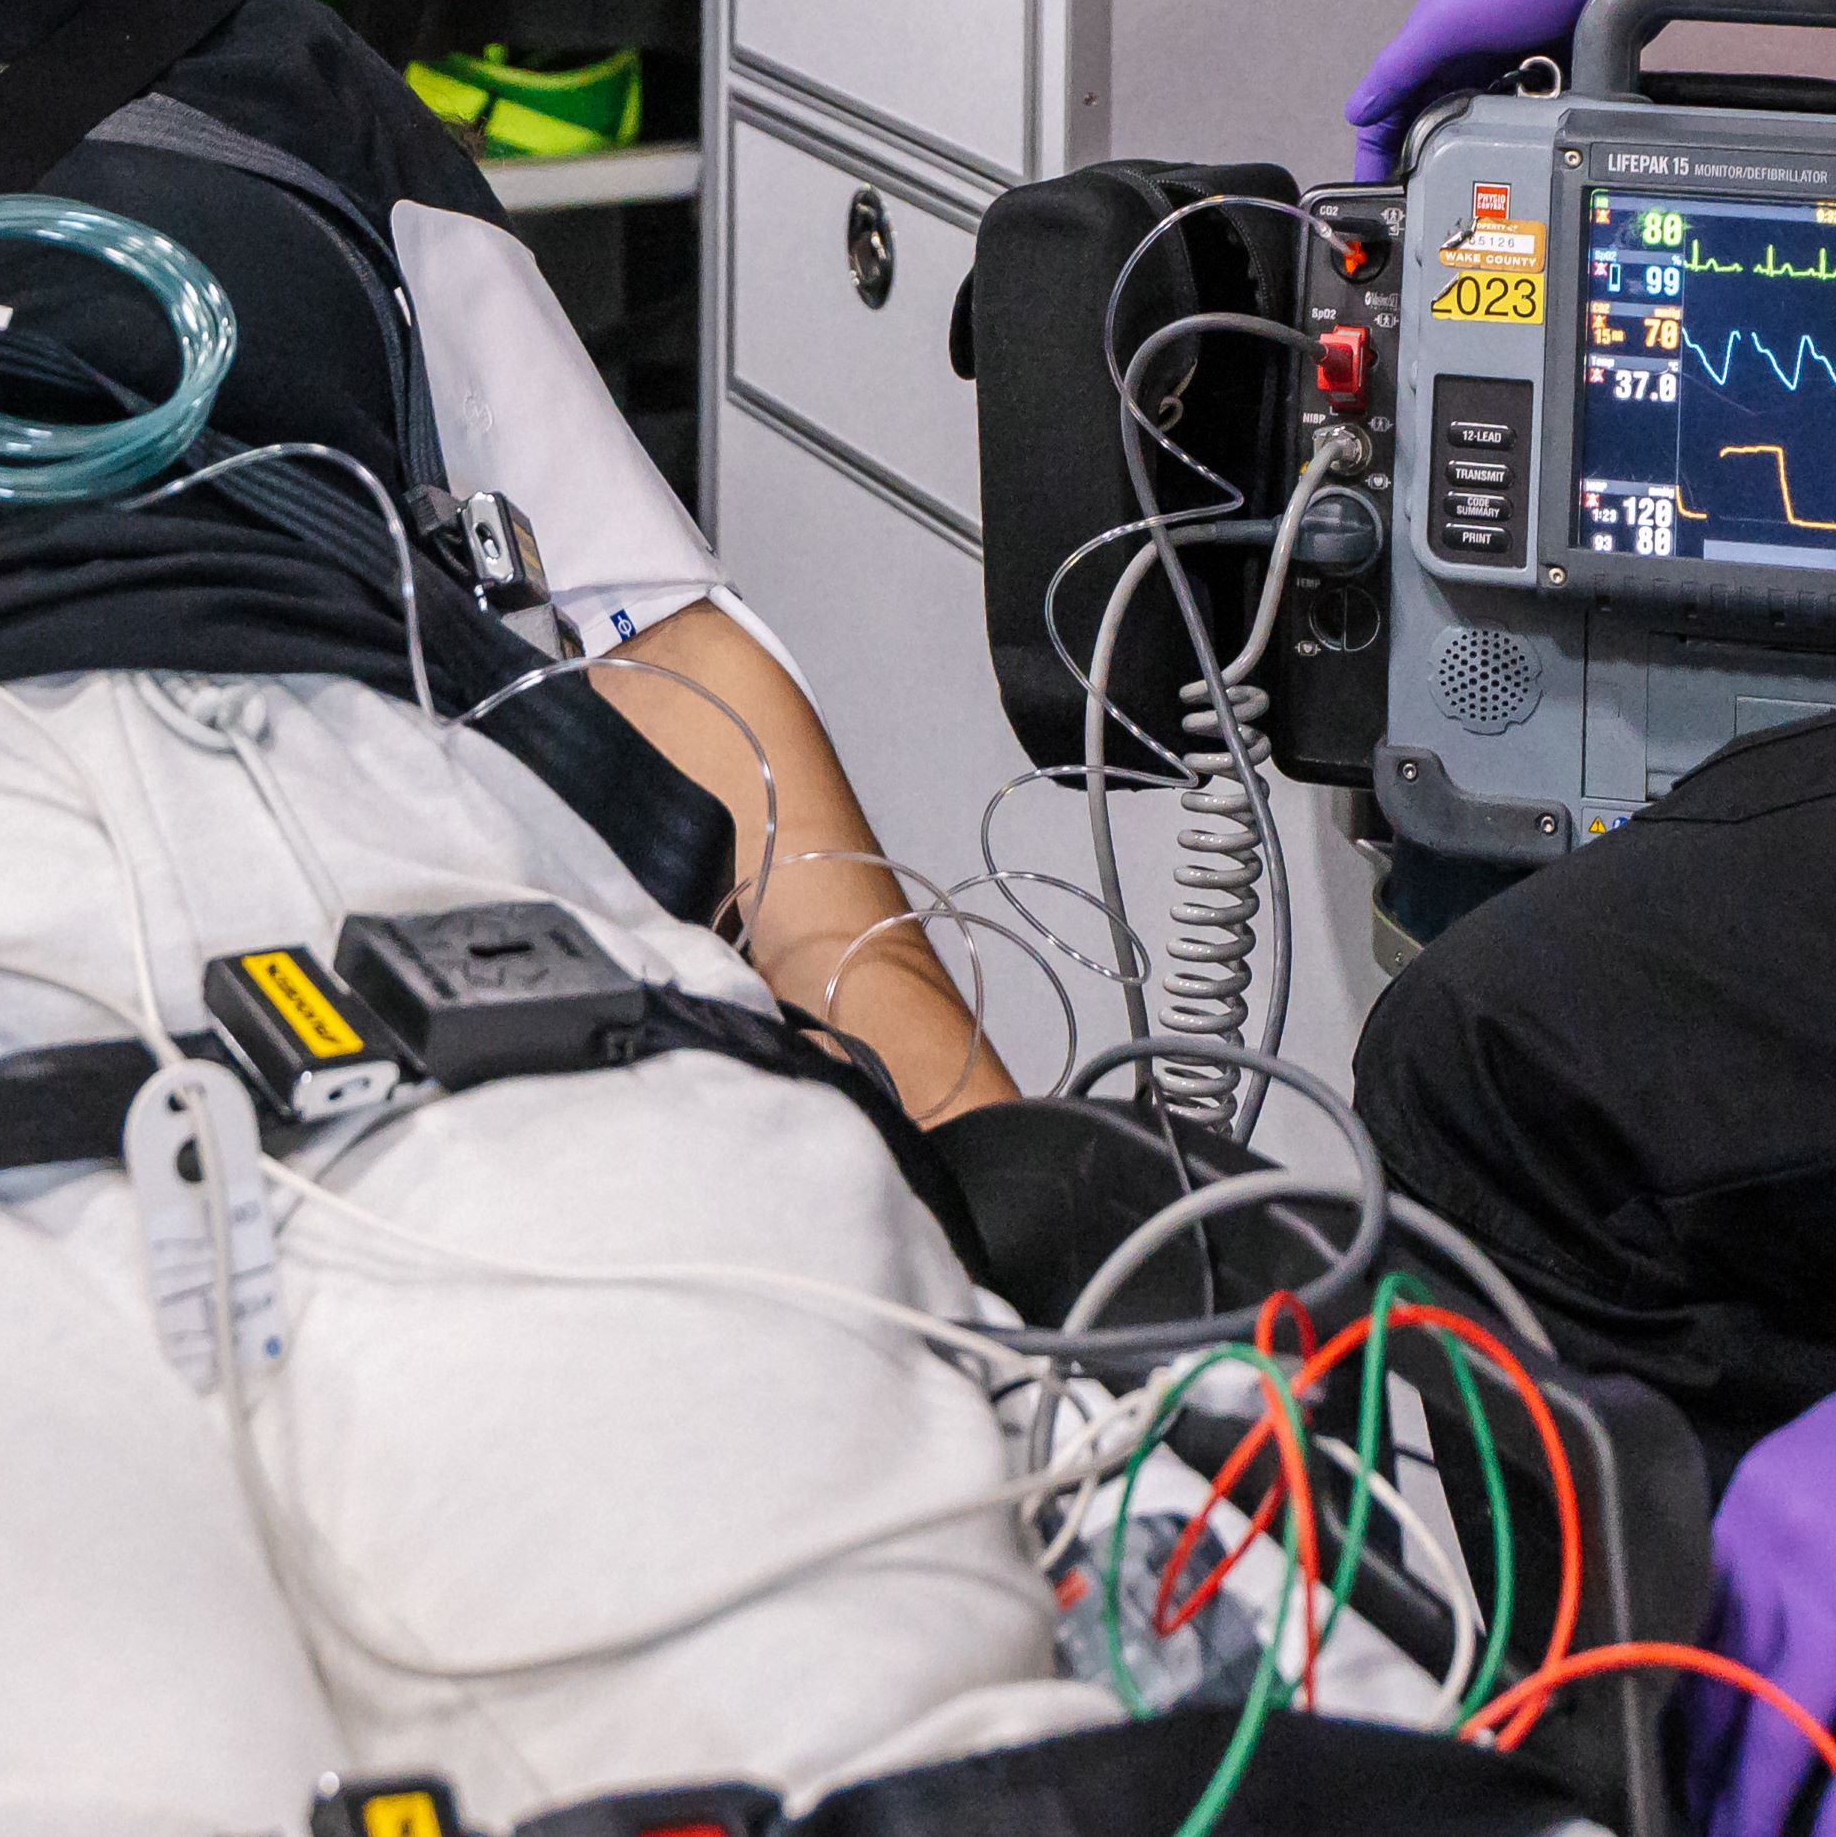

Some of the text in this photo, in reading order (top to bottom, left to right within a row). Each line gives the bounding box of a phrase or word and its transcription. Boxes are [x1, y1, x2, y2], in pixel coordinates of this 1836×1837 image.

[1608, 153, 1828, 184] LIFEPAK 15 MONITOR/DEFIBRILLATOR
[1477, 193, 1506, 204] PHYSIO
[1477, 202, 1505, 211] CONTROL
[1319, 205, 1339, 217] CO2
[1643, 212, 1683, 246] 80
[1445, 251, 1537, 268] WAKE COUNTY
[1645, 265, 1680, 297] 99
[1594, 328, 1611, 346] 15
[1644, 318, 1679, 350] 70
[1615, 370, 1677, 402] 37.0
[1302, 412, 1327, 424] NIBP
[1462, 430, 1502, 443] 12-LEAD
[1455, 468, 1505, 483] TRANSMIT
[1467, 497, 1490, 507] CODE
[1456, 504, 1500, 518] SUMMARY
[1622, 496, 1673, 528] 120
[1462, 531, 1492, 545] PRINT
[1636, 525, 1671, 556] 80
